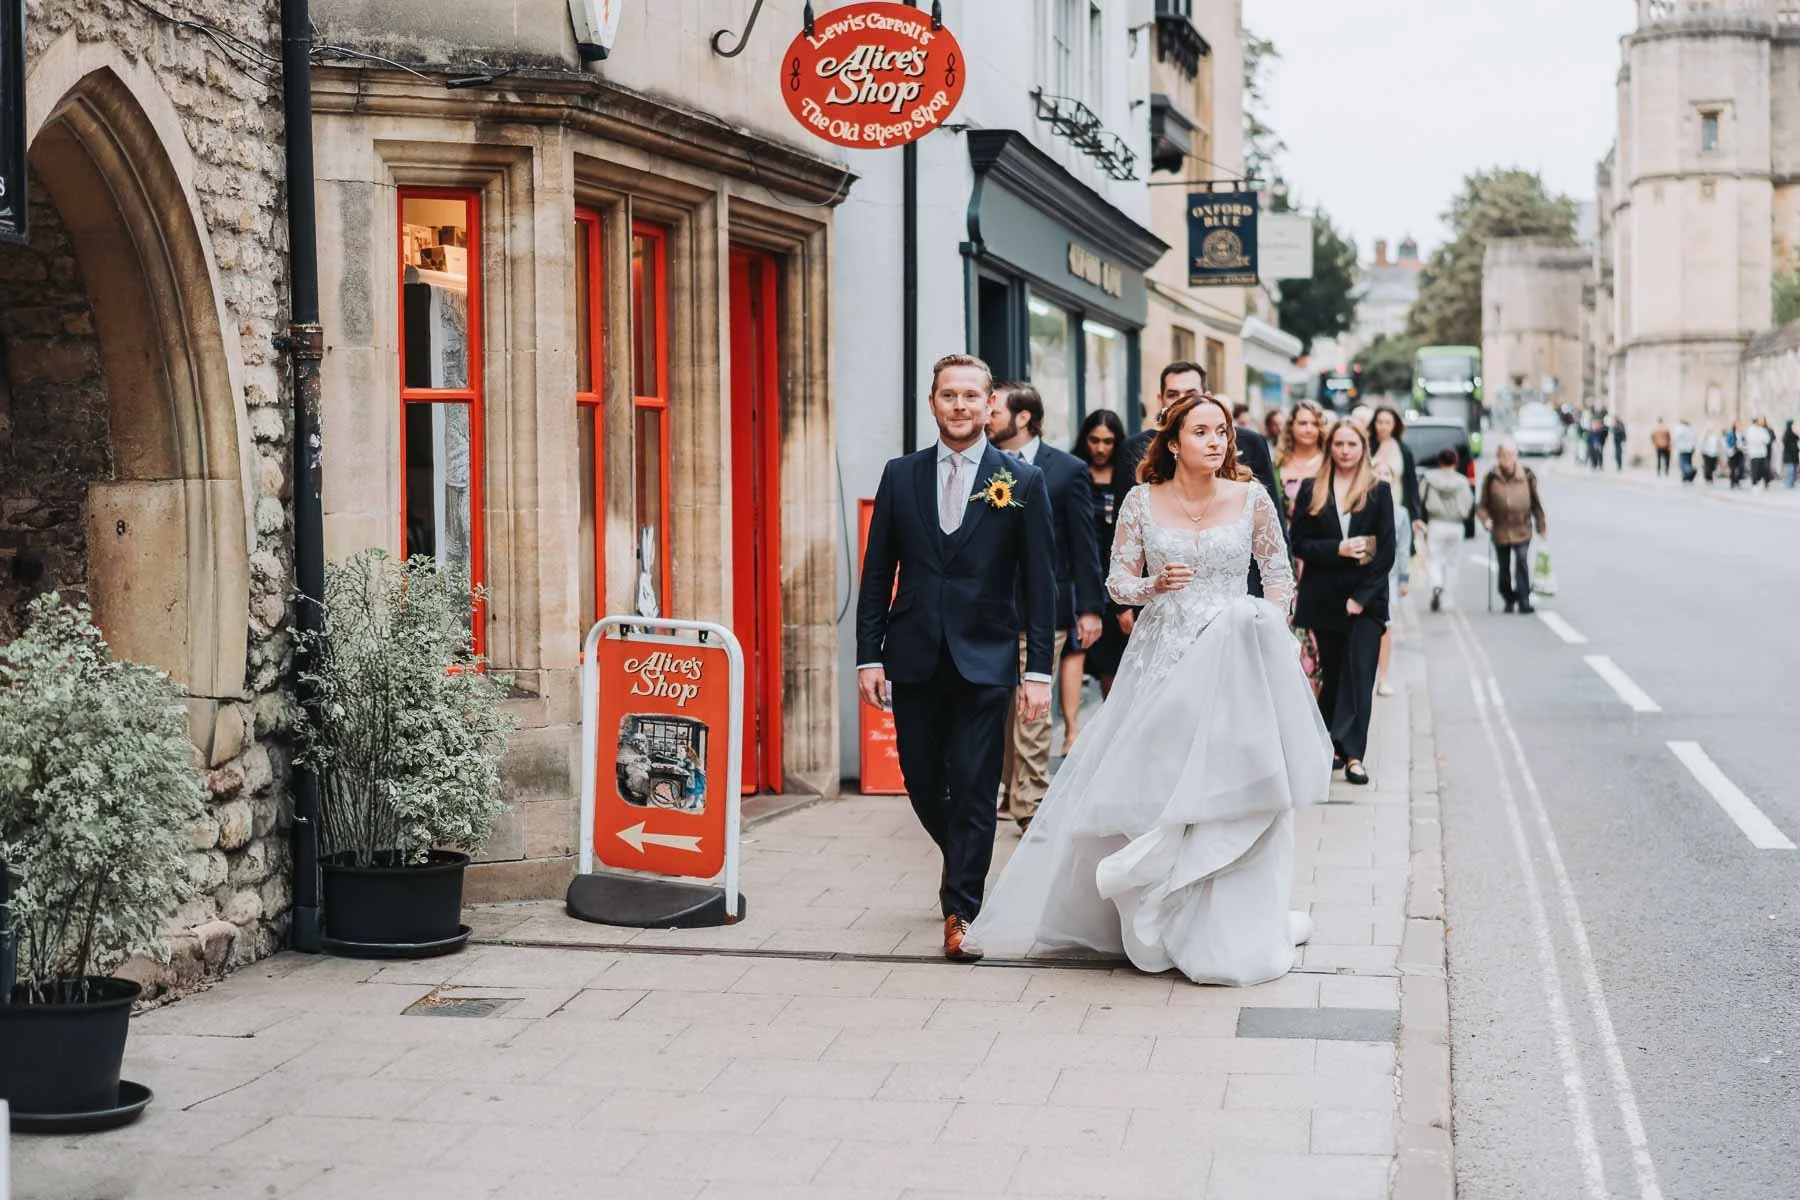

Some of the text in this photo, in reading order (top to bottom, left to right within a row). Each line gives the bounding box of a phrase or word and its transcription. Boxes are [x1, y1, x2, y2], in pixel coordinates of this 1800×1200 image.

[806, 13, 935, 50] Lewis Carroll's
[816, 45, 928, 79] Alice's
[825, 67, 924, 113] Shop
[801, 90, 949, 147] The Old Sheep Shop
[1192, 203, 1254, 218] OXFORD
[623, 651, 704, 680] Alice's
[630, 667, 701, 707] Shop
